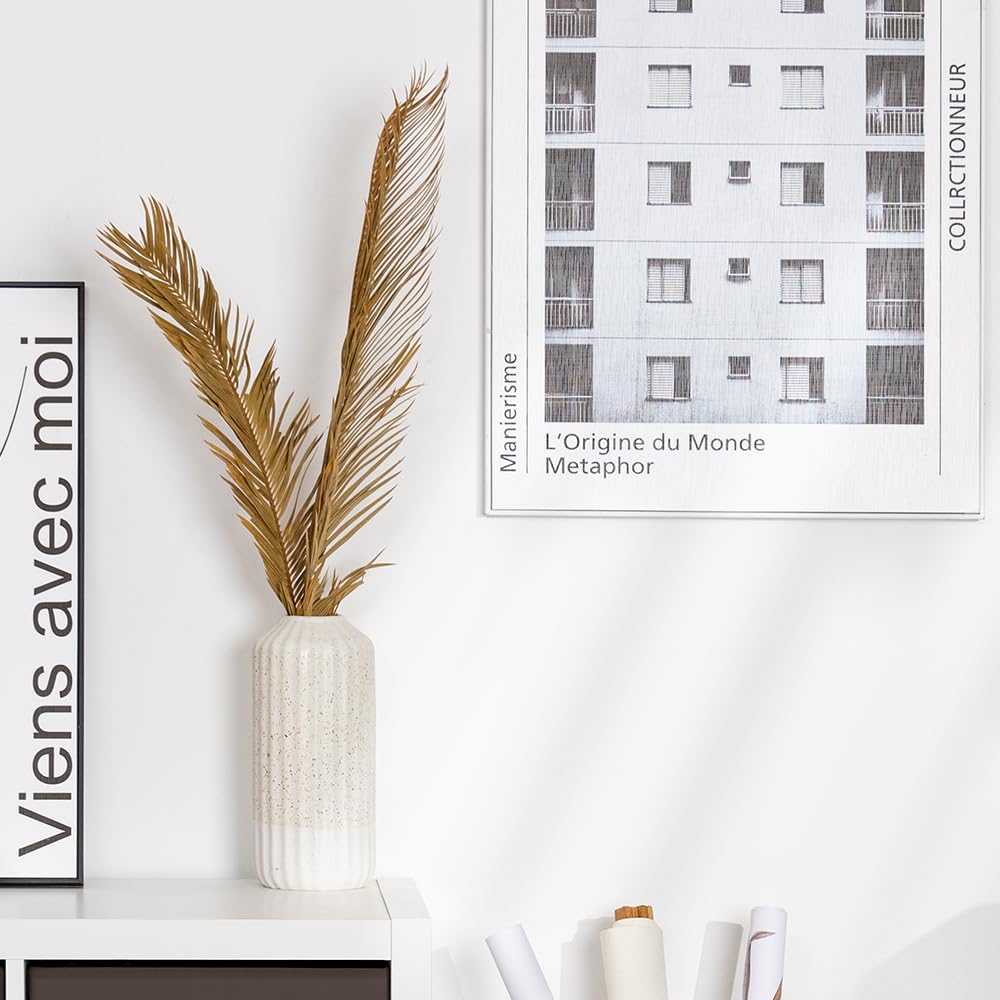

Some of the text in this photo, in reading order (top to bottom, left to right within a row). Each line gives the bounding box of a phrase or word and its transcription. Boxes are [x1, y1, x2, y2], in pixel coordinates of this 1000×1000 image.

[949, 63, 966, 252] COLLRCTIONNEUR
[499, 352, 518, 472] Manierisme
[545, 433, 766, 456] L’Origine du Monde
[545, 456, 655, 479] Metaphor
[18, 336, 73, 858] Viens avec moi
